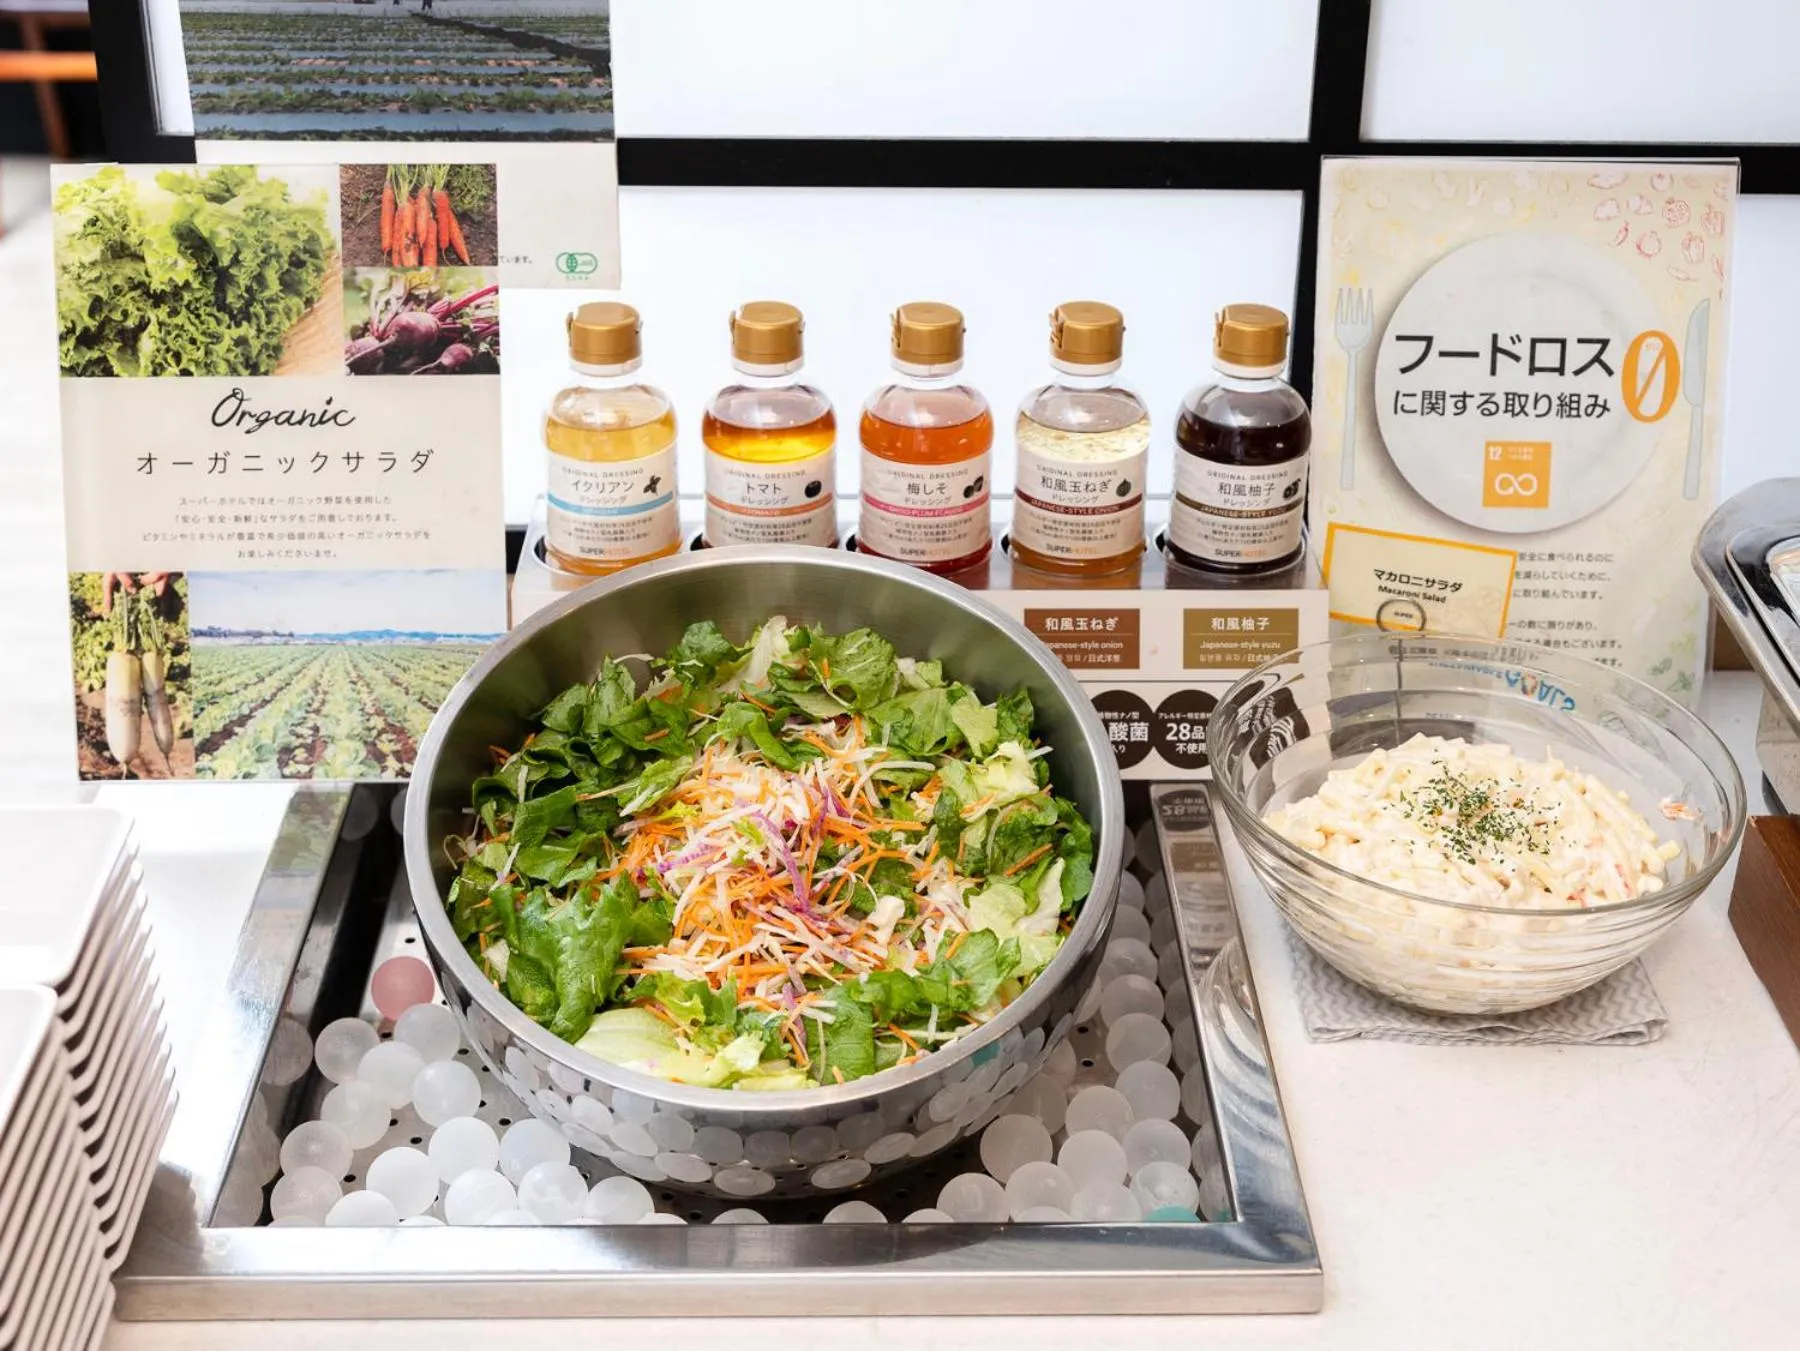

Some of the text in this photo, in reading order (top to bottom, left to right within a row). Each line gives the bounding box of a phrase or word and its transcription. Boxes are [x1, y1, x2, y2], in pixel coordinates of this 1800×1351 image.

[1395, 333, 1615, 377] フードロス
[210, 387, 356, 434] Organic
[1393, 389, 1612, 419] に関する取り組み
[1487, 445, 1503, 461] 12
[136, 448, 435, 475] オーガニックサラダ
[1077, 469, 1118, 478] DRESSING
[1207, 470, 1246, 481] ORIGINAL
[572, 479, 635, 494] イタリアン
[746, 482, 782, 495] トマト
[907, 482, 948, 495] 梅しそ
[1040, 476, 1112, 493] 和風玉ねぎ
[1218, 481, 1276, 497] 和風柚子
[904, 496, 952, 506] ドレッシング
[1223, 497, 1272, 507] ドレッシング
[1373, 568, 1464, 593] マカロニサラダ
[1378, 585, 1447, 603] Macaroni Salad
[1513, 588, 1603, 600] に取り組んでいます。
[1045, 616, 1119, 631] 和風玉ねぎ
[1211, 616, 1270, 631] 和風柚子
[1101, 641, 1124, 650] onion
[1200, 640, 1281, 650] Japanese-style yuzu
[1108, 721, 1149, 742] 酸菌
[1166, 722, 1207, 741] 28品
[1175, 742, 1208, 755] 不使用
